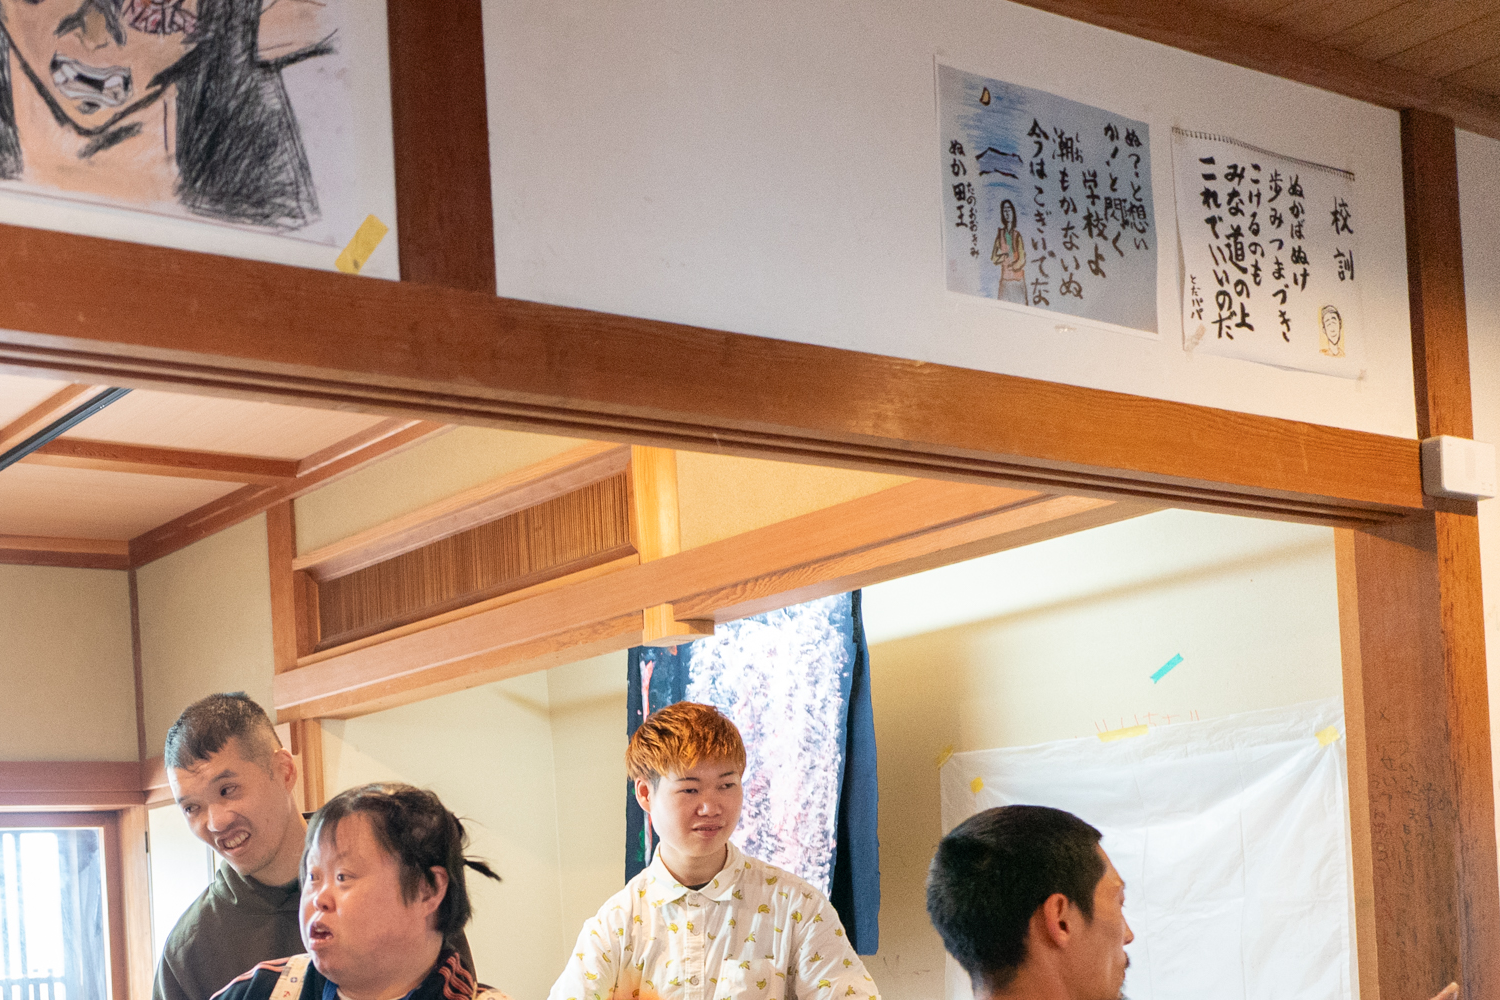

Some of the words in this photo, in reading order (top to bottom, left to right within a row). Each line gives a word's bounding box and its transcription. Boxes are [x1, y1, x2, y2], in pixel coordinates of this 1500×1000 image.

[1082, 170, 1108, 278] 学校よ
[1199, 156, 1234, 341] これでいいのだ
[1224, 163, 1255, 332] みな道の上
[1248, 163, 1265, 286] こけるのも
[1288, 174, 1310, 292] ぬかばぬけ
[1331, 196, 1355, 281] 校訓
